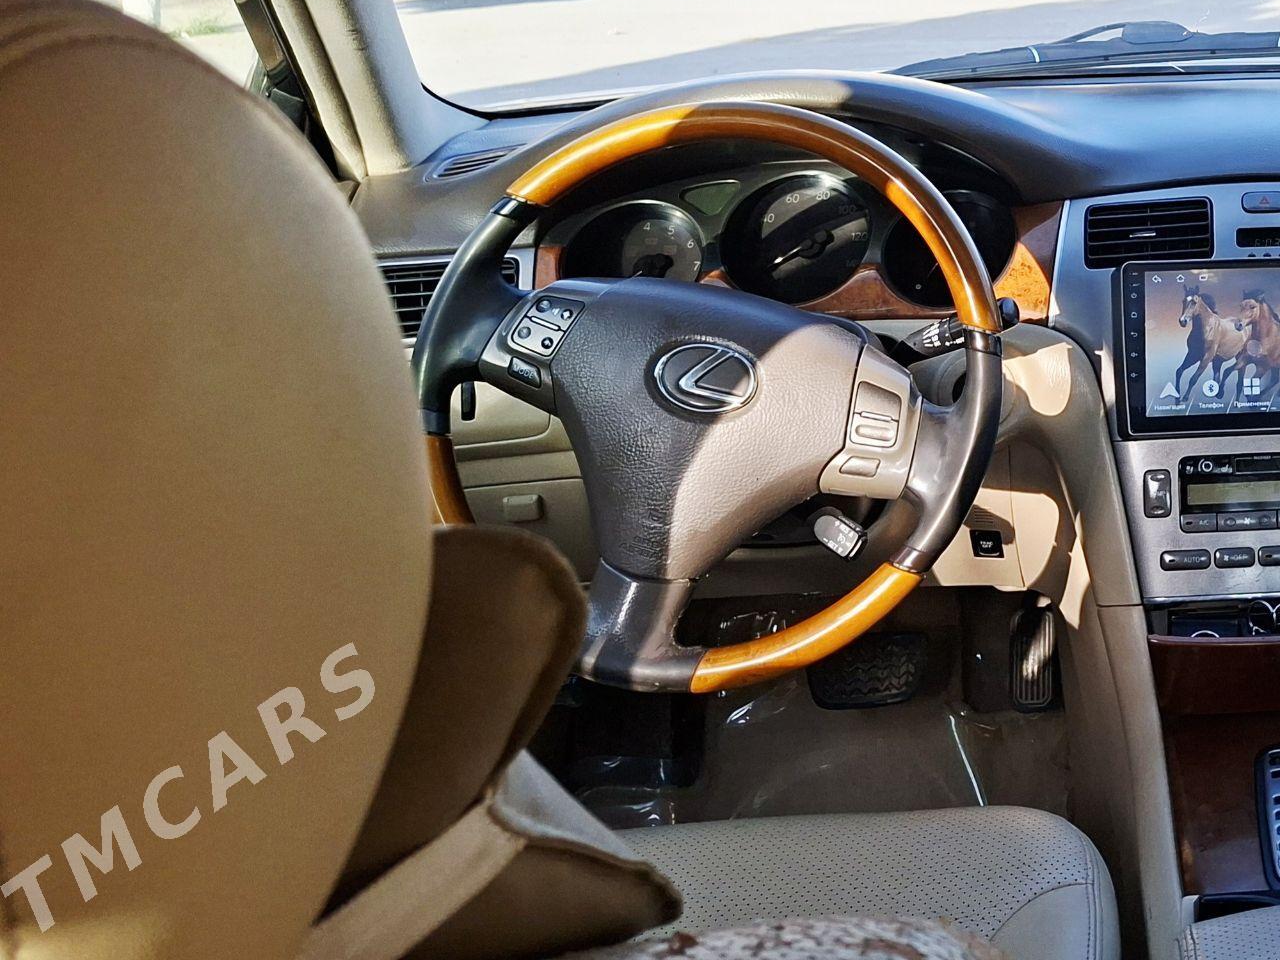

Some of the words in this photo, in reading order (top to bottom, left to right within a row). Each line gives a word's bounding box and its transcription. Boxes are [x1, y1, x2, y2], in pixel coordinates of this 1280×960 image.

[786, 193, 800, 204] 60
[815, 190, 831, 201] 80
[643, 222, 651, 231] 4
[667, 225, 675, 235] 5
[686, 239, 695, 249] 6
[693, 261, 701, 271] 7
[512, 362, 534, 379] MODE
[1183, 556, 1201, 564] AUTO
